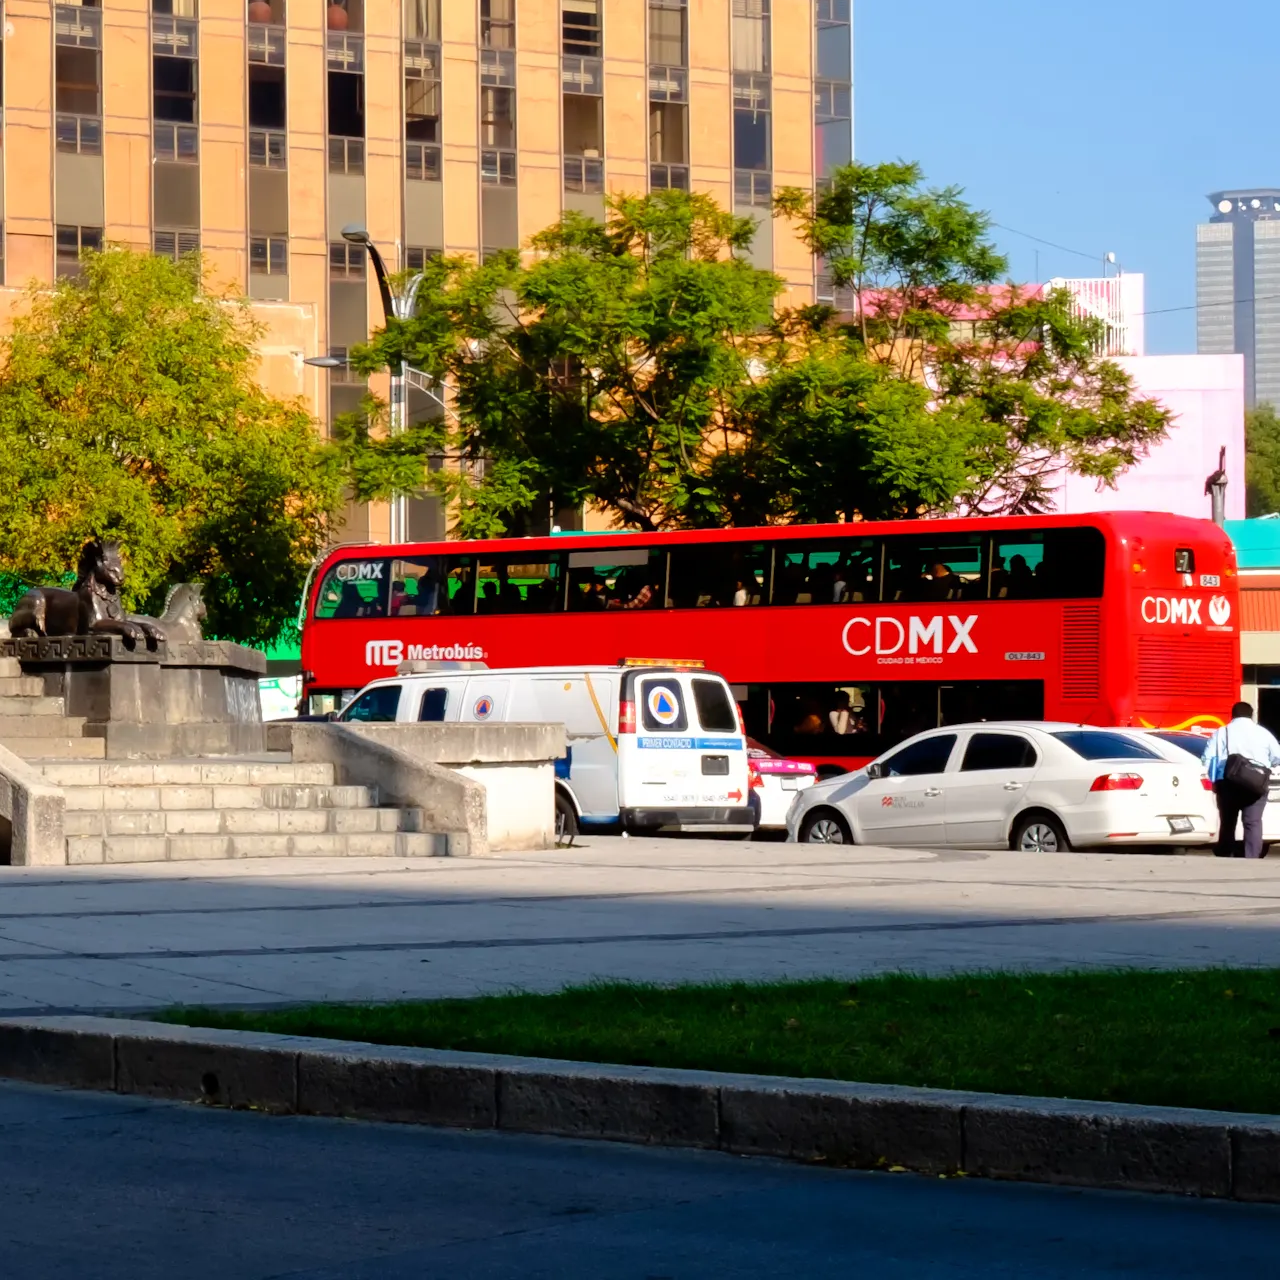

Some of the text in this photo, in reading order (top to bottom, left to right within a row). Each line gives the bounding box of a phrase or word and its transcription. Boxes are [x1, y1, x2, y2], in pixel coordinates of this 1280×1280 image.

[336, 563, 384, 580] CDMX
[1202, 576, 1218, 586] 843
[1141, 596, 1202, 625] CDMX
[842, 615, 979, 656] CDMX
[407, 642, 483, 660] Metrobús
[876, 657, 903, 665] CIUDAD
